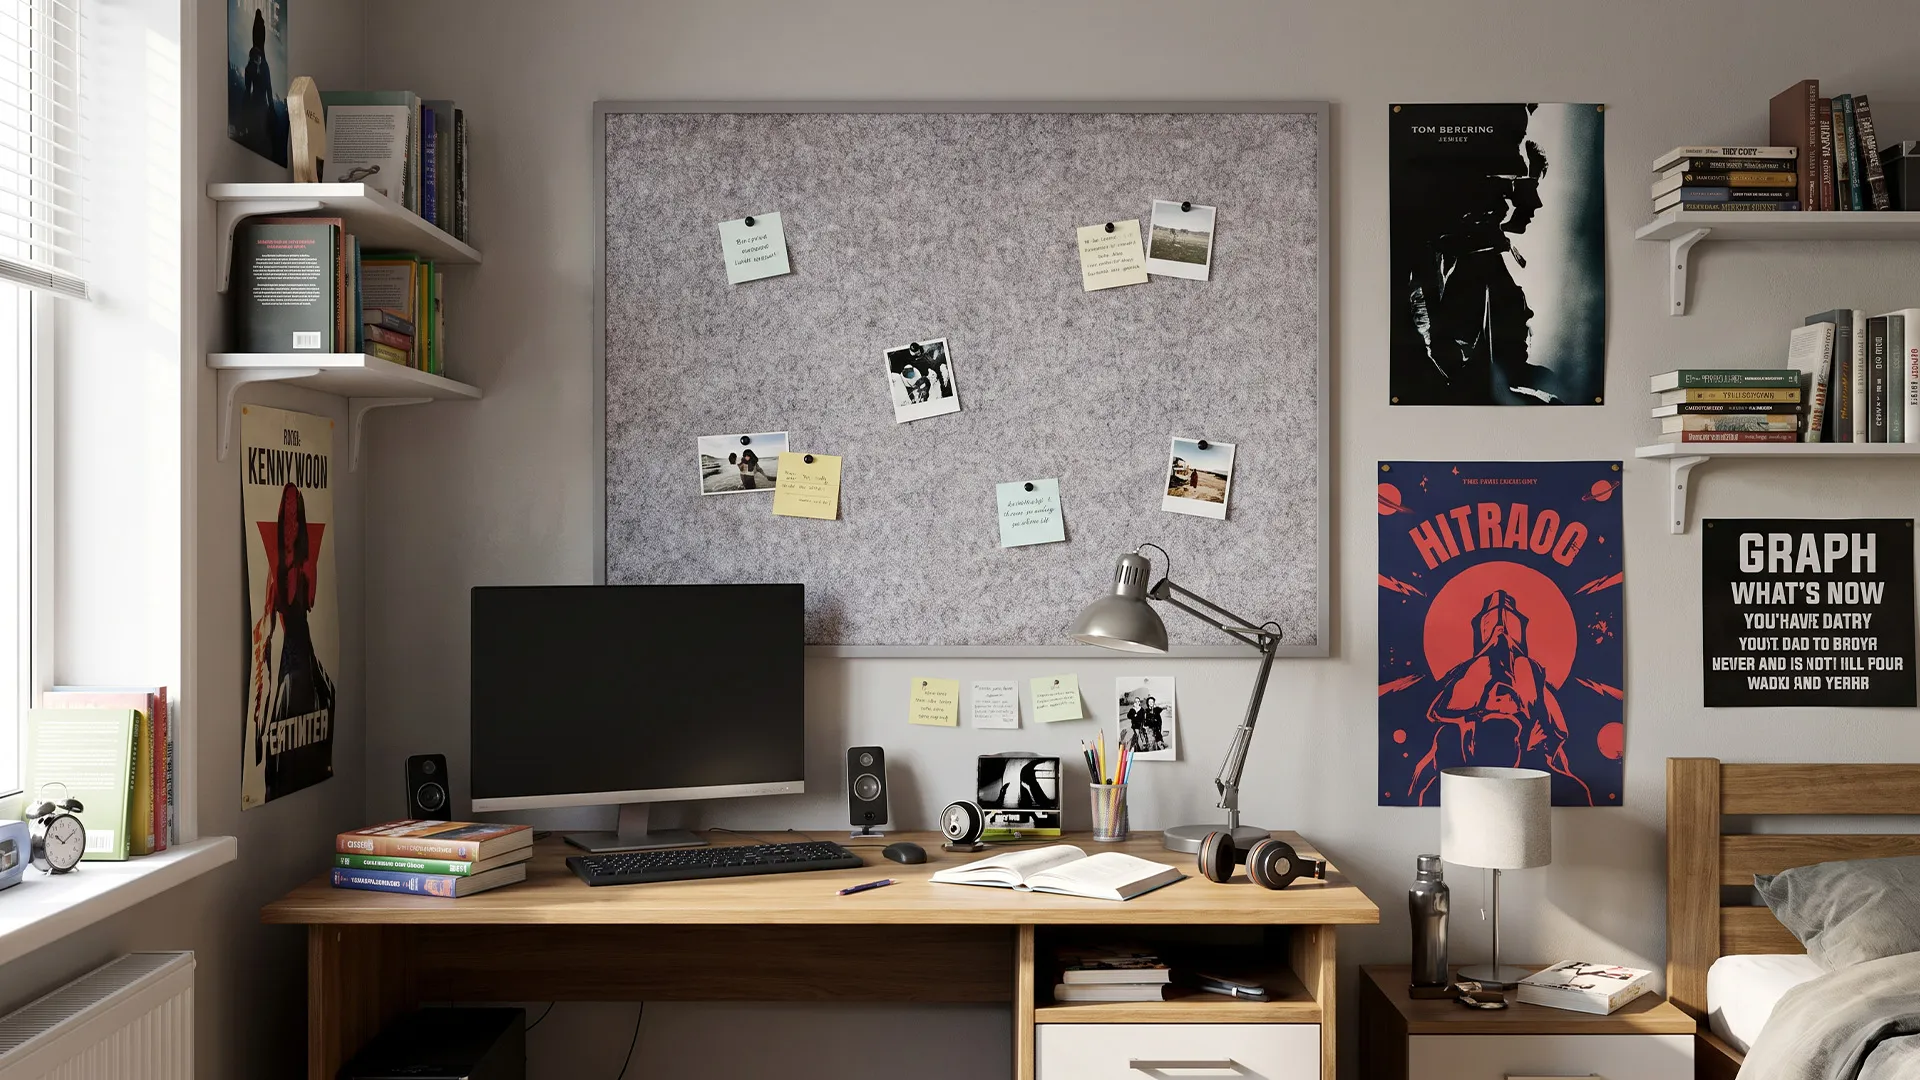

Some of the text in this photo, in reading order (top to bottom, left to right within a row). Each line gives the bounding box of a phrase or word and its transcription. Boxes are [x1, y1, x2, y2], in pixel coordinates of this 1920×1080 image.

[1411, 126, 1436, 134] TOM
[248, 446, 328, 489] KENNY WOON
[1739, 532, 1877, 574] GRAPH
[1730, 581, 1885, 605] WHAT'S NOW
[1822, 612, 1873, 630] DATRY
[1782, 637, 1810, 651] DAD
[1812, 637, 1830, 651] TO
[1712, 656, 1756, 671] NEVER
[1758, 656, 1787, 671] AND
[1790, 656, 1804, 671] IS
[1793, 676, 1822, 690] AND
